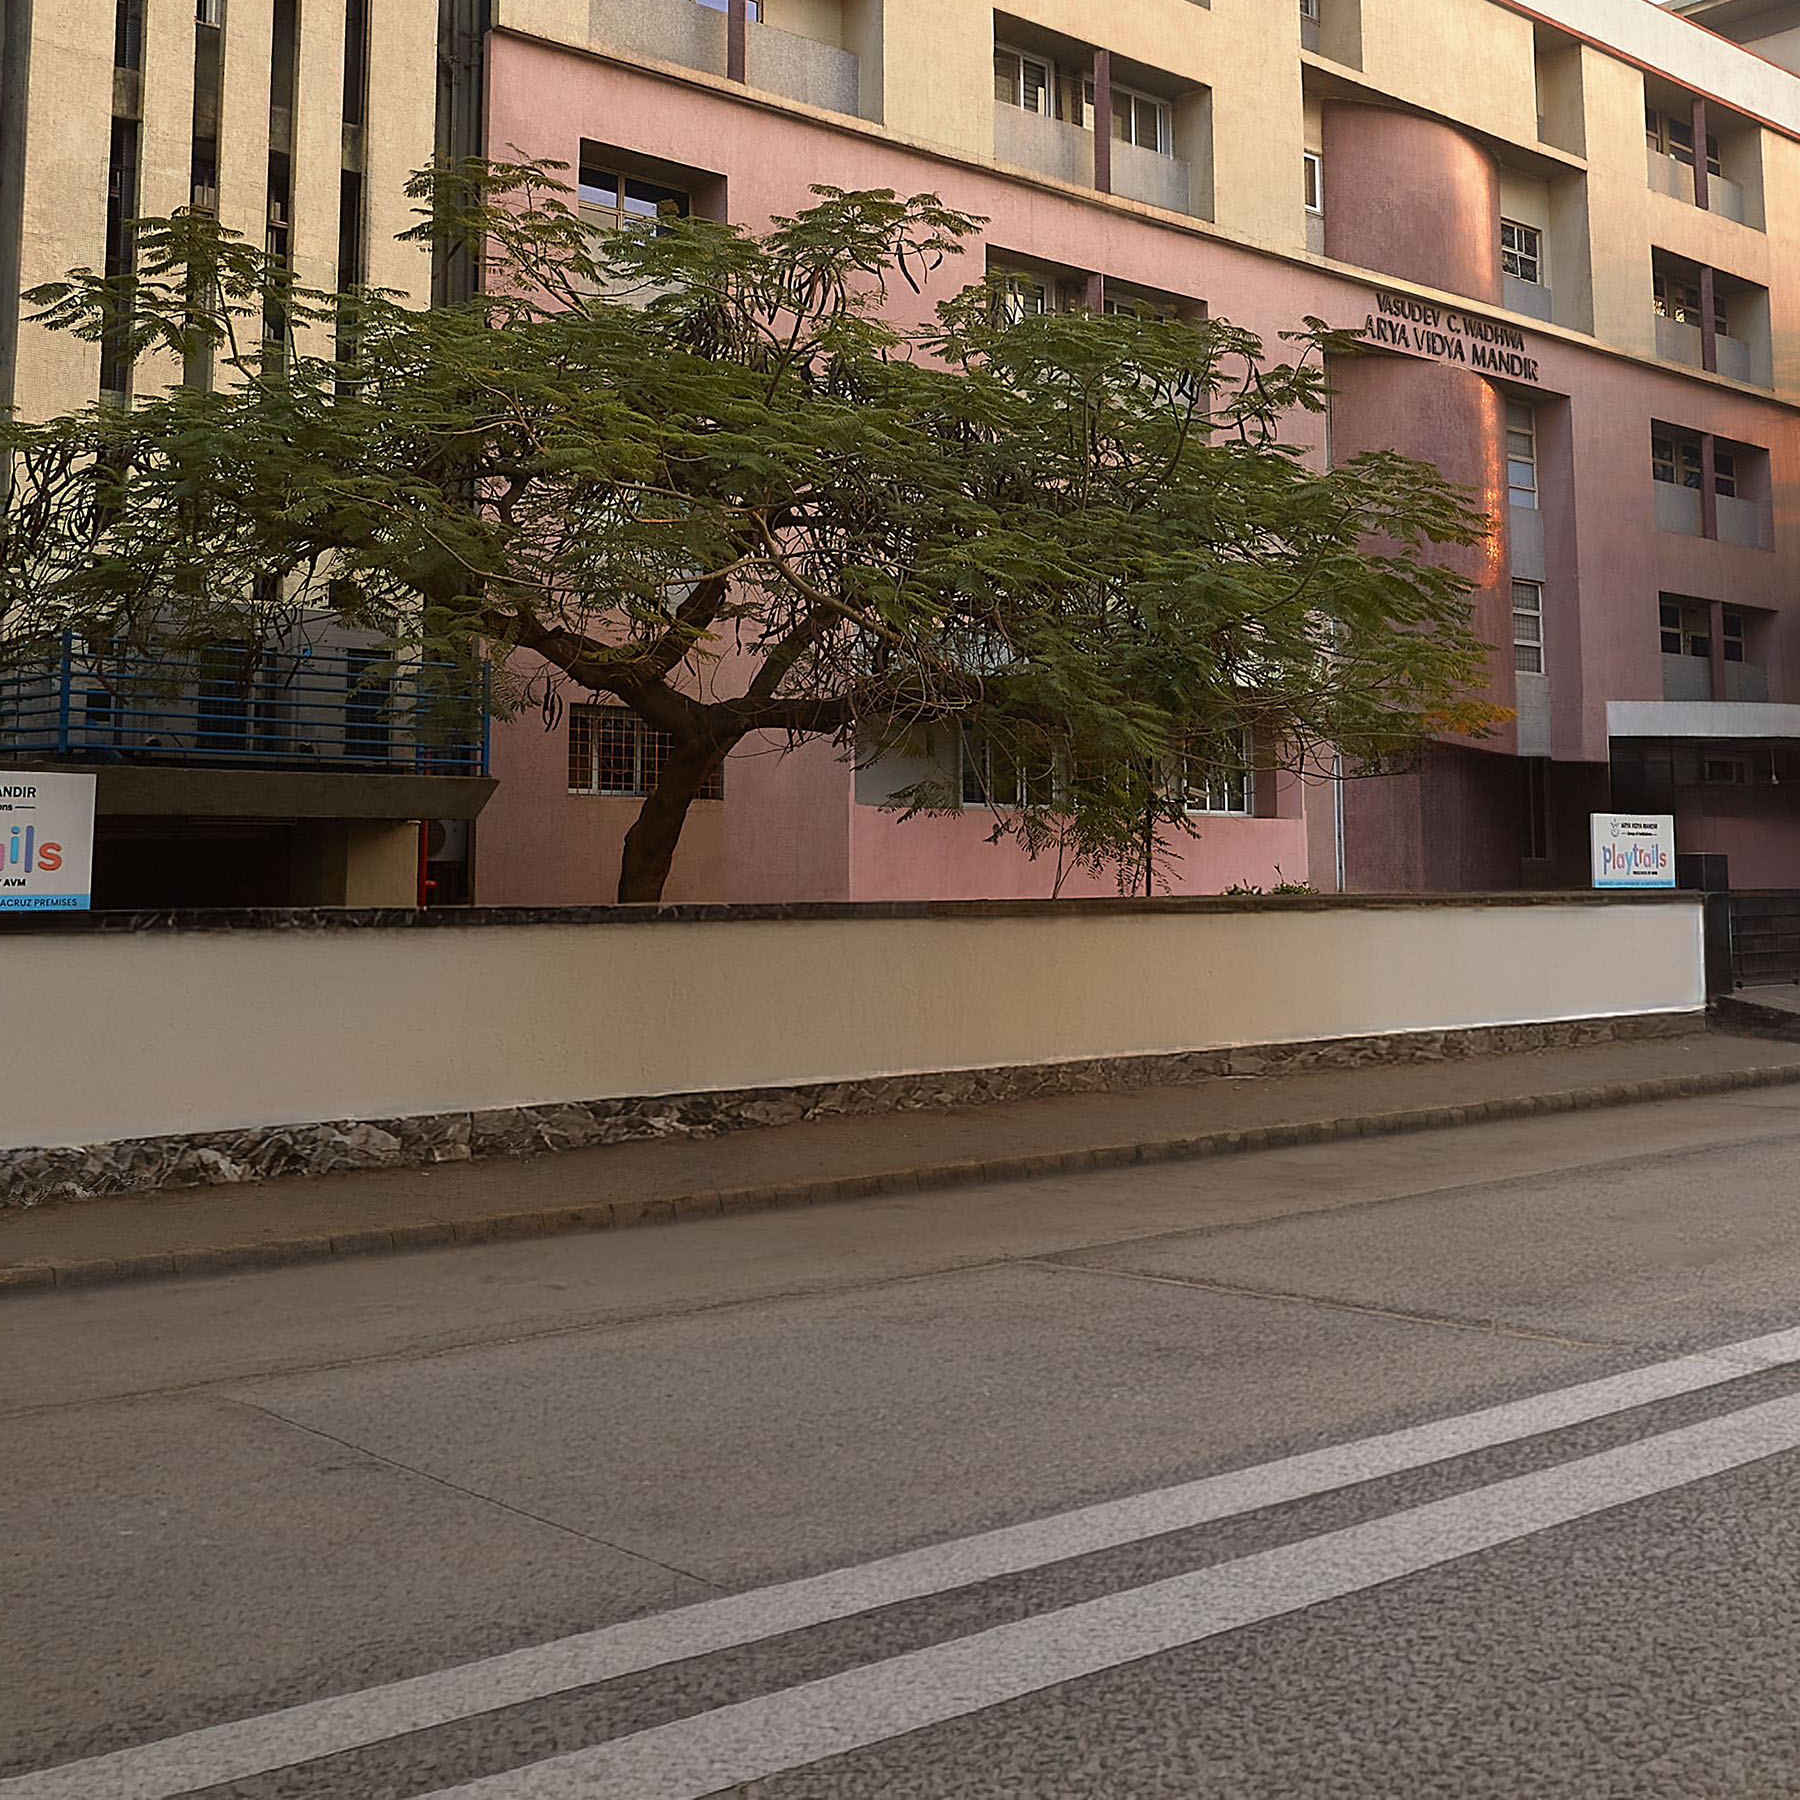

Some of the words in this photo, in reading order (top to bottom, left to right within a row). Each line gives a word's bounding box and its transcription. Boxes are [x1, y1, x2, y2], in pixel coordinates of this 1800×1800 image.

[1376, 293, 1440, 327] VASUDEV
[1463, 317, 1525, 352] WADHWA
[1366, 314, 1410, 348] ARYA
[1413, 327, 1465, 361] VIDYA
[1472, 343, 1539, 381] MANDIR
[1602, 843, 1667, 875] playtrails
[3, 878, 26, 887] AVM
[34, 898, 78, 907] PREMISES
